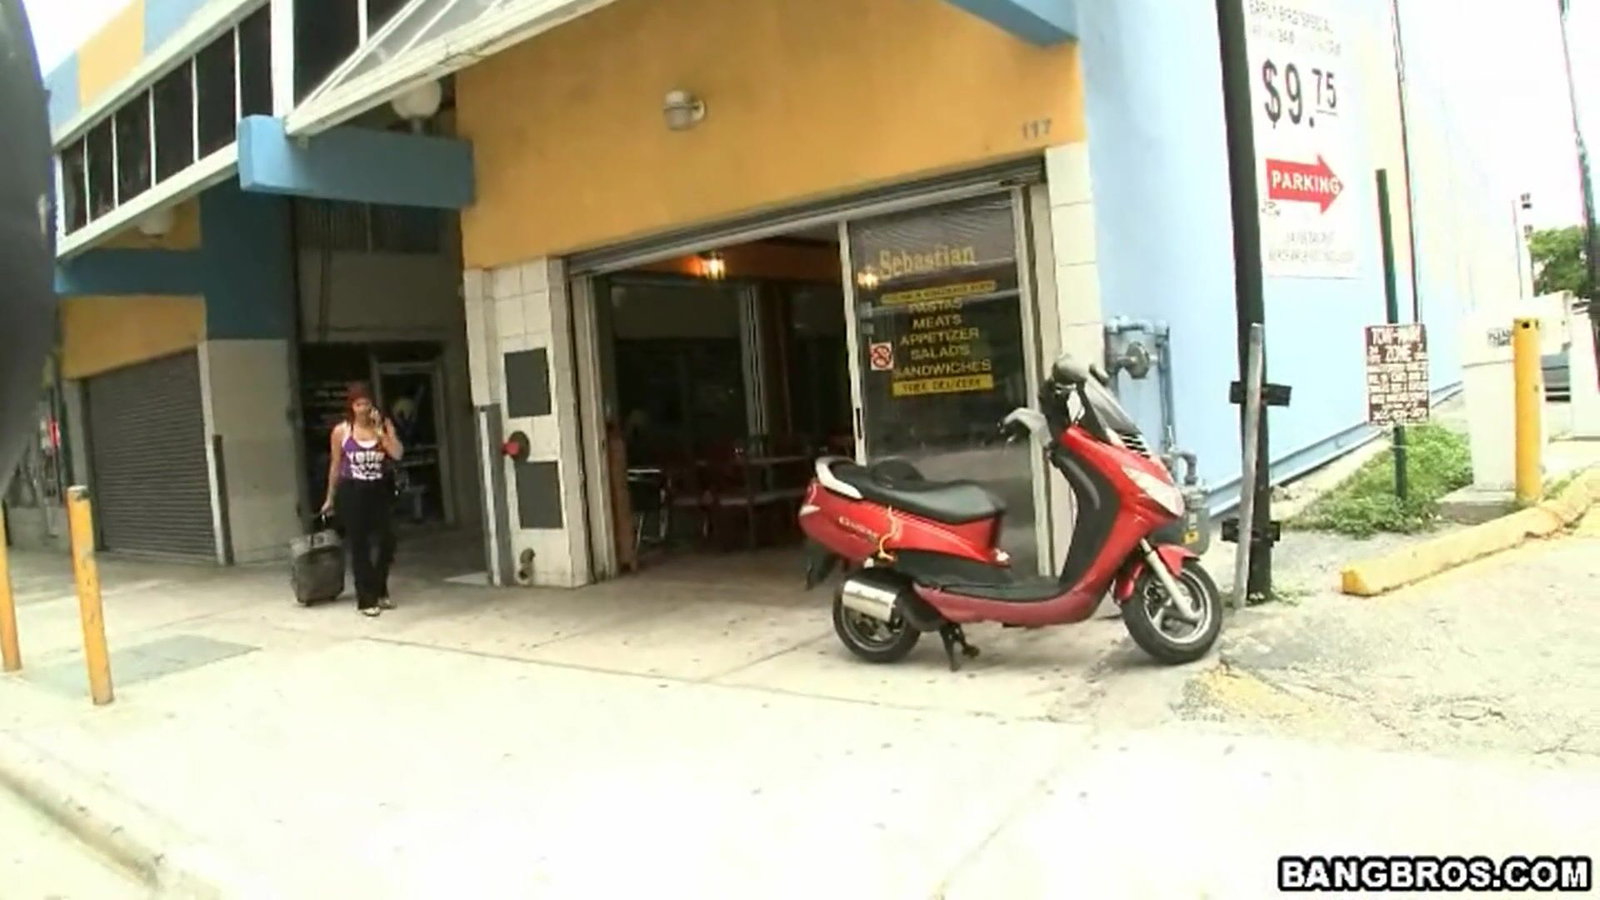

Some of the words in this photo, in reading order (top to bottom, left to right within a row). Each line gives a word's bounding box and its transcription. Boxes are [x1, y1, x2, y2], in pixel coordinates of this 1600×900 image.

[1022, 118, 1052, 139] 117
[1271, 170, 1341, 194] PARKING
[879, 246, 975, 280] Sebastian
[908, 298, 963, 313] PASTAS
[912, 314, 963, 329] MEATS
[900, 328, 980, 346] APPETIZER
[1385, 344, 1413, 361] ZONE
[894, 359, 992, 378] SANDWICHES
